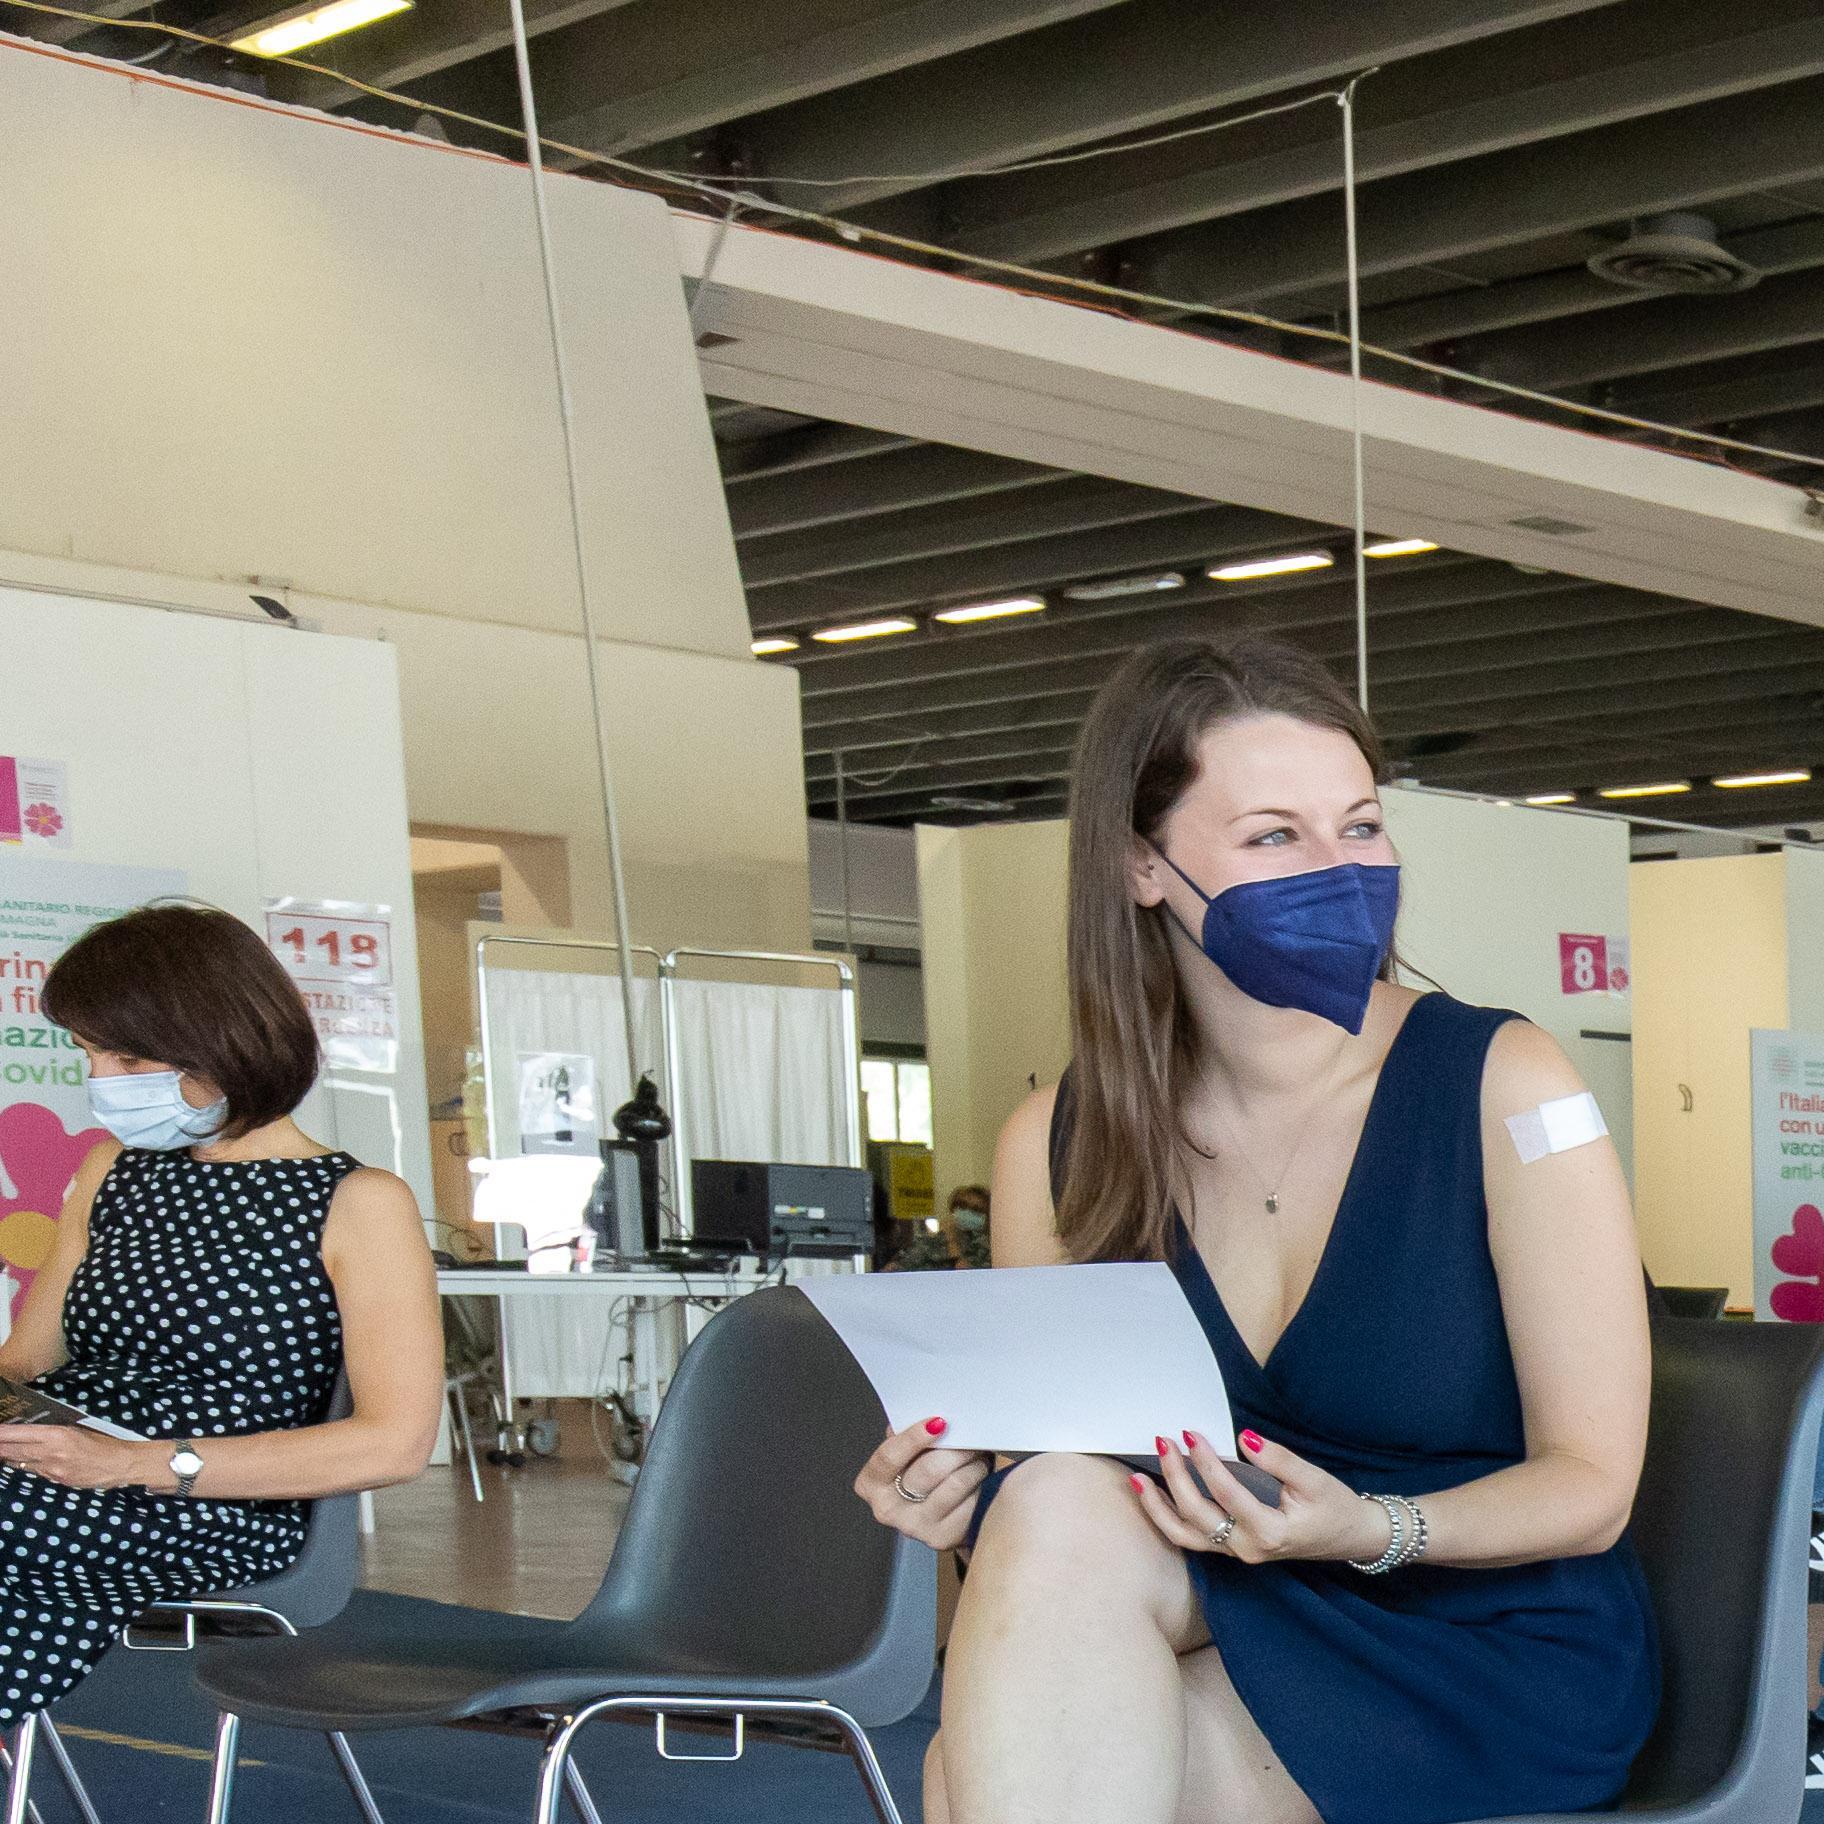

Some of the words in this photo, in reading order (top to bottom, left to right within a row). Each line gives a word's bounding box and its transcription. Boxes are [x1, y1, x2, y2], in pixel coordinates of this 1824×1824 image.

[282, 926, 378, 969] 118
[1574, 946, 1595, 990] 8
[1779, 1119, 1811, 1134] con
